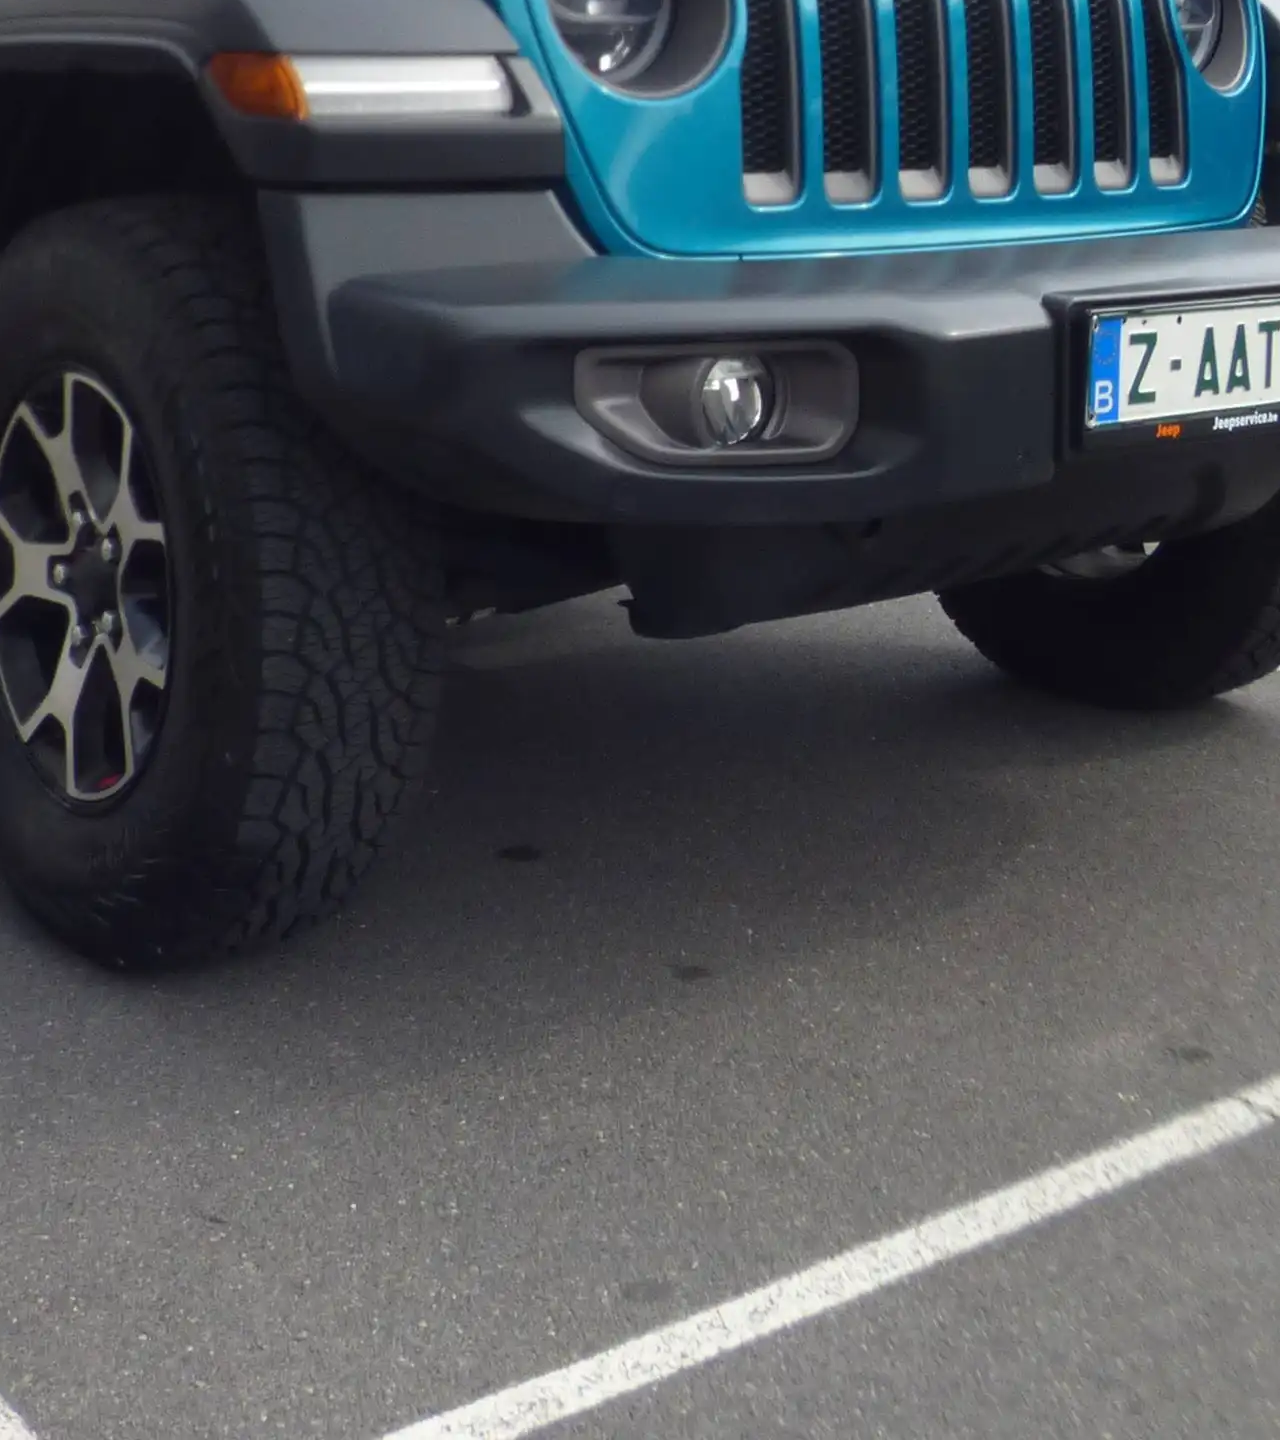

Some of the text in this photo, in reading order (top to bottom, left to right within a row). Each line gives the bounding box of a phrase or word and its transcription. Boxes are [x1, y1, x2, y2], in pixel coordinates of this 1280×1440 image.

[1094, 380, 1114, 414] B
[1155, 422, 1180, 438] Jeep
[1212, 409, 1279, 432] Jeepservice.be
